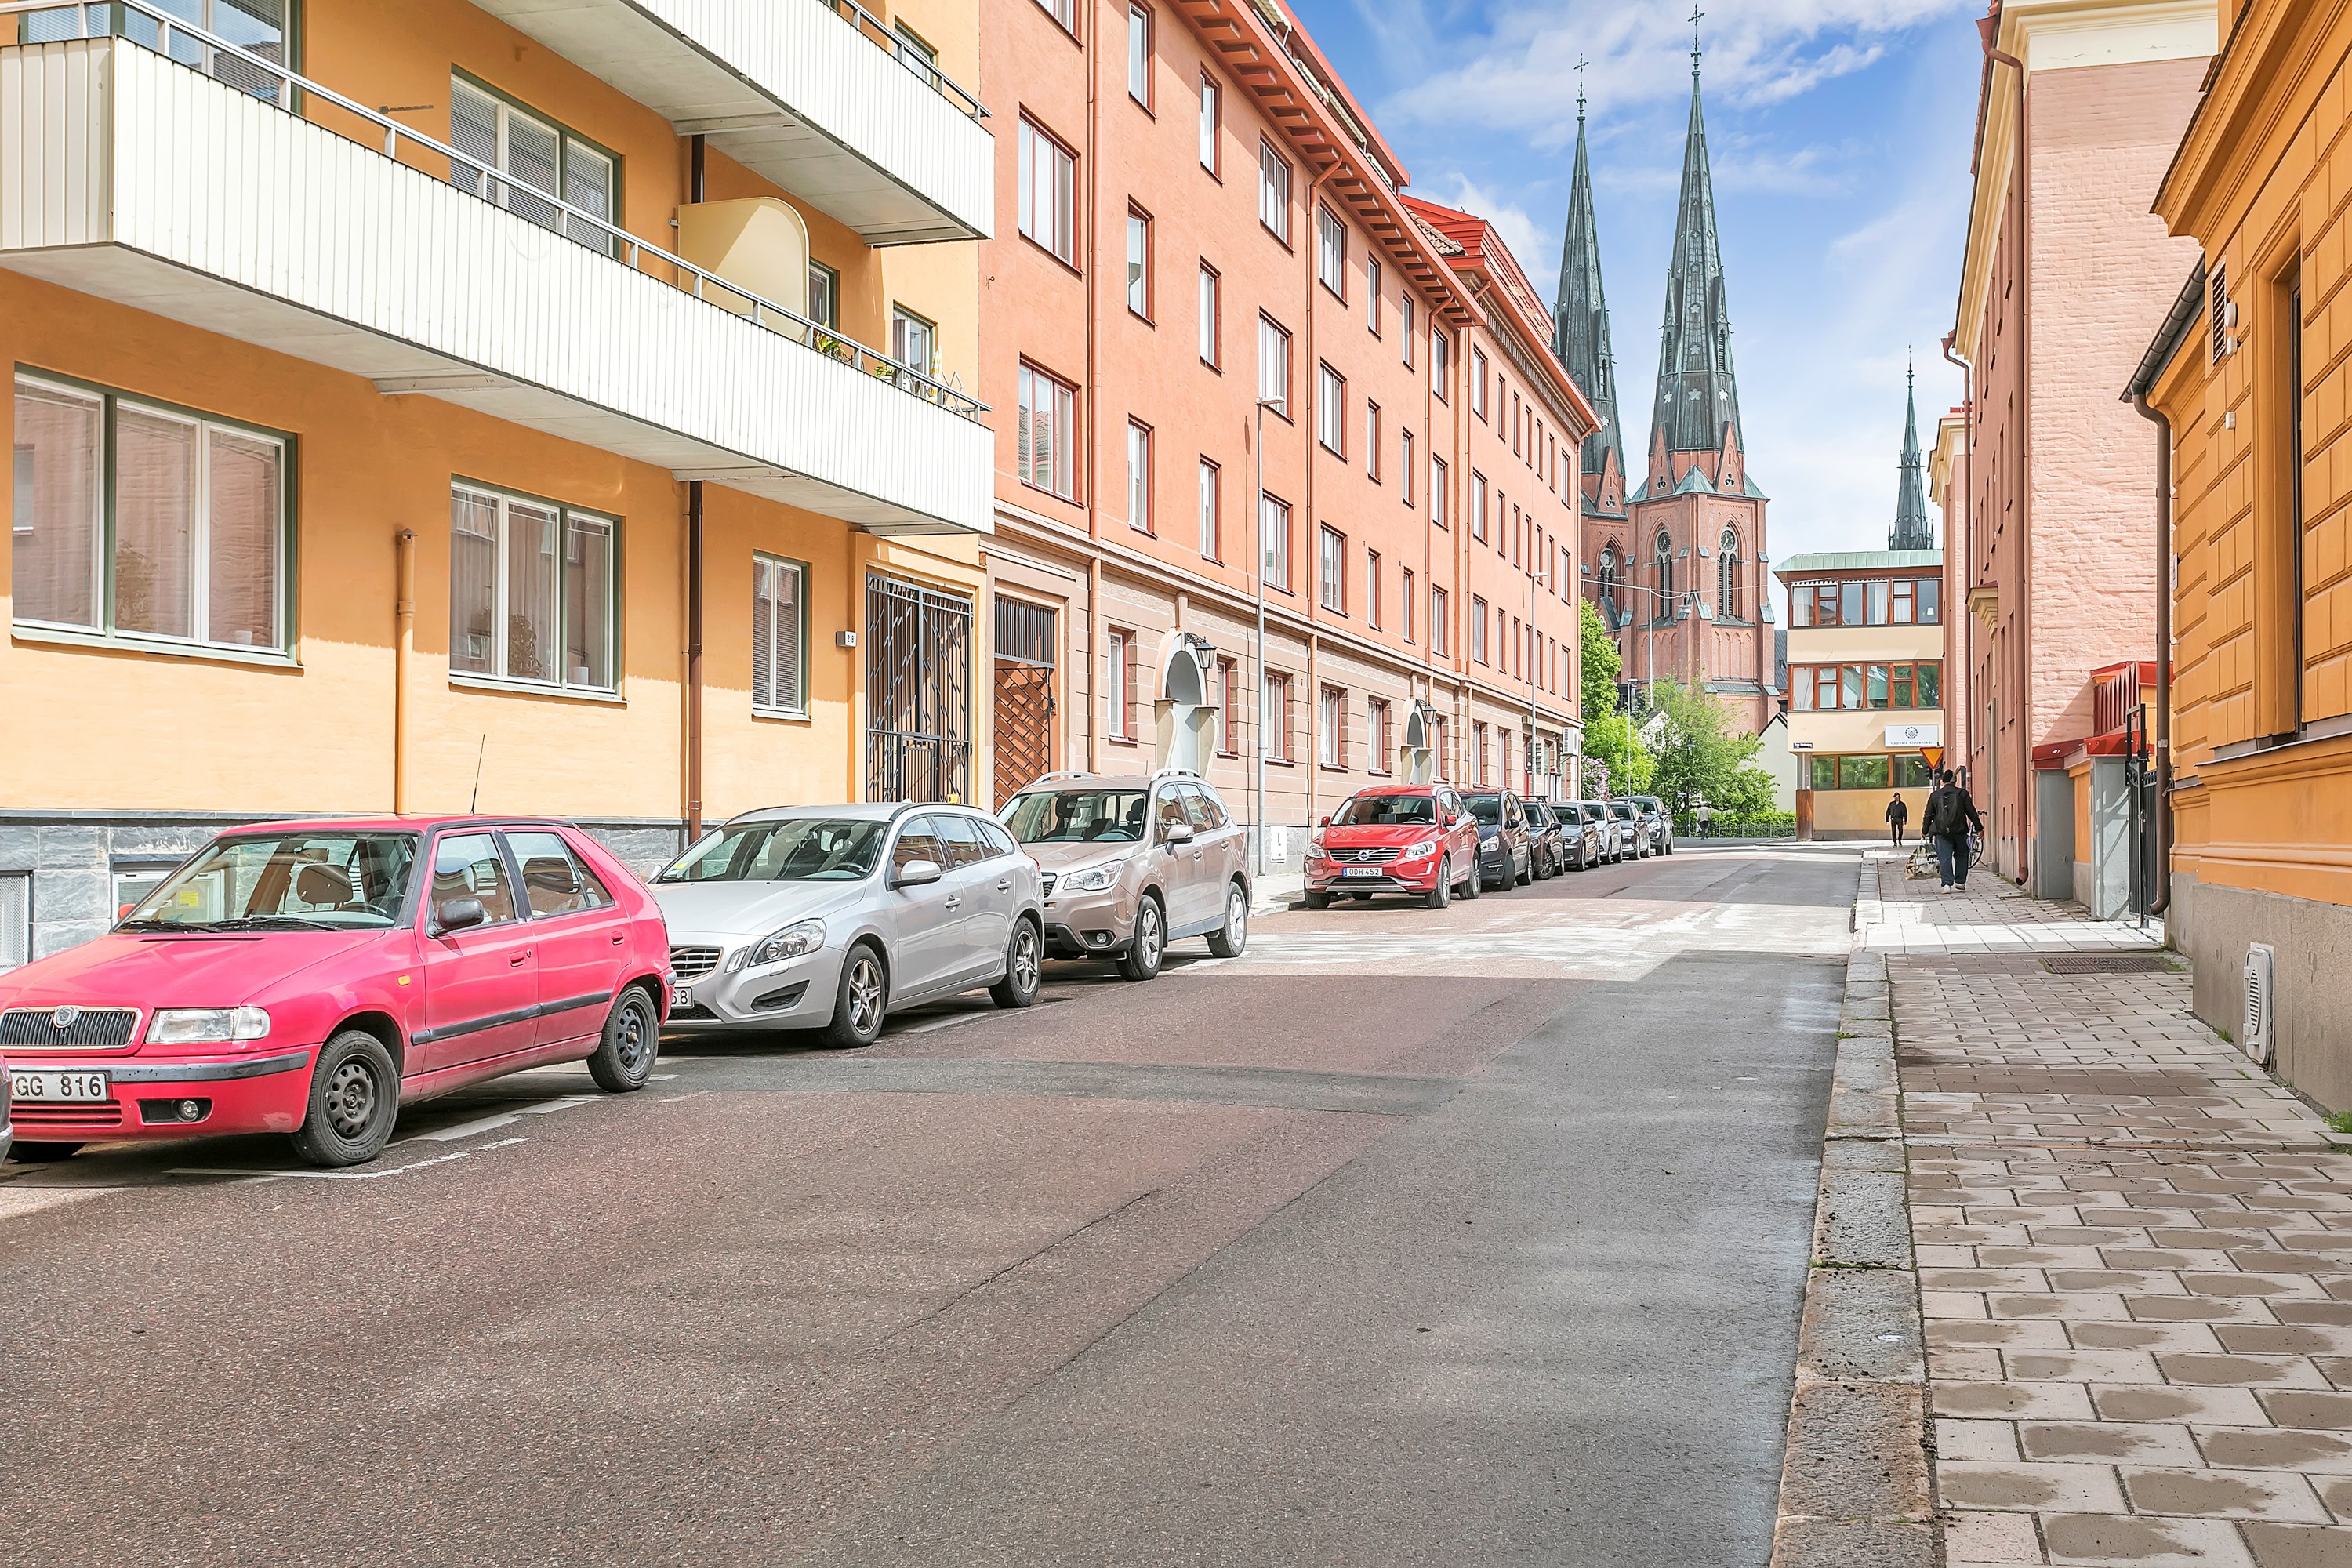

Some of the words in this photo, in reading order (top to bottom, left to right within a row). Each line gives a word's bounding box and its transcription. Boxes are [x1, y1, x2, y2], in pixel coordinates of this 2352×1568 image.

[847, 634, 855, 643] 28
[12, 1076, 44, 1097] GG
[60, 1076, 102, 1097] 816
